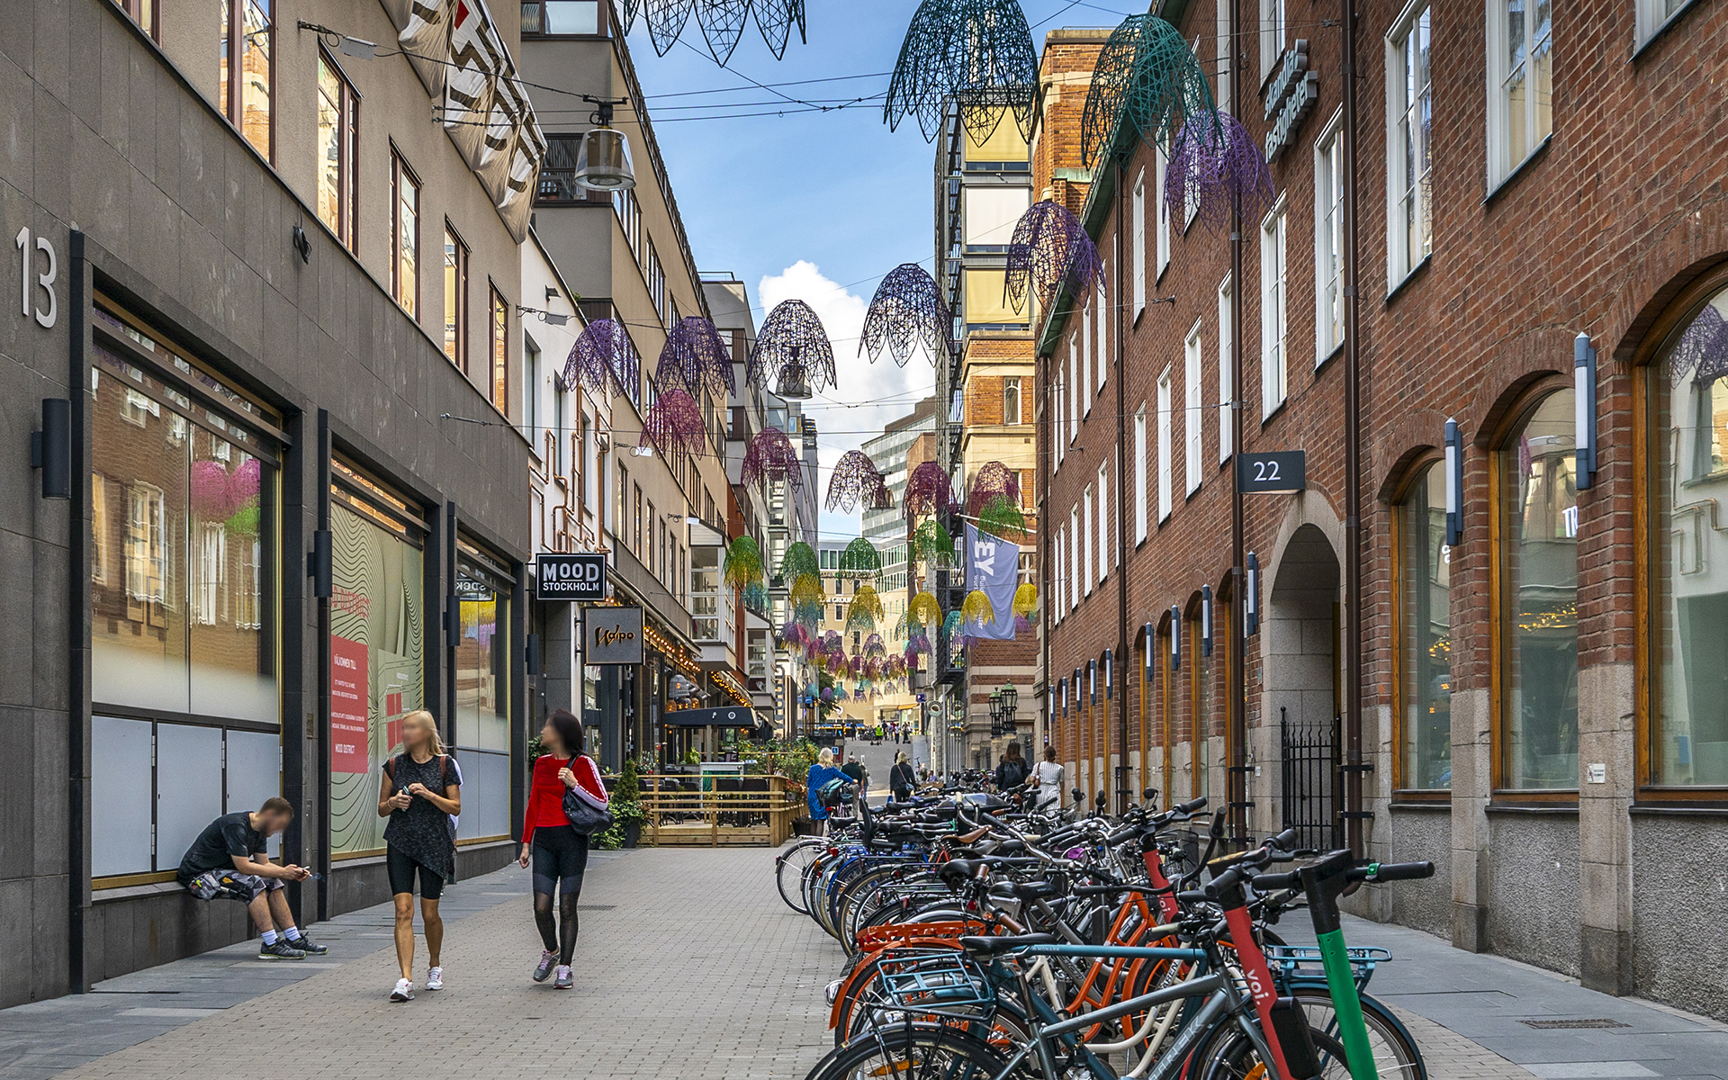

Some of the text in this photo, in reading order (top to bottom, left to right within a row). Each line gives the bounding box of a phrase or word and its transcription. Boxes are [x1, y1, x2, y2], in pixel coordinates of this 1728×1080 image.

[16, 226, 57, 328] 13
[1253, 460, 1281, 482] 22
[543, 563, 600, 582] MOOD
[974, 540, 995, 576] EY
[543, 582, 600, 591] STOCKHOLM
[1247, 968, 1270, 1006] voi.
[1147, 1015, 1205, 1080] TREK
